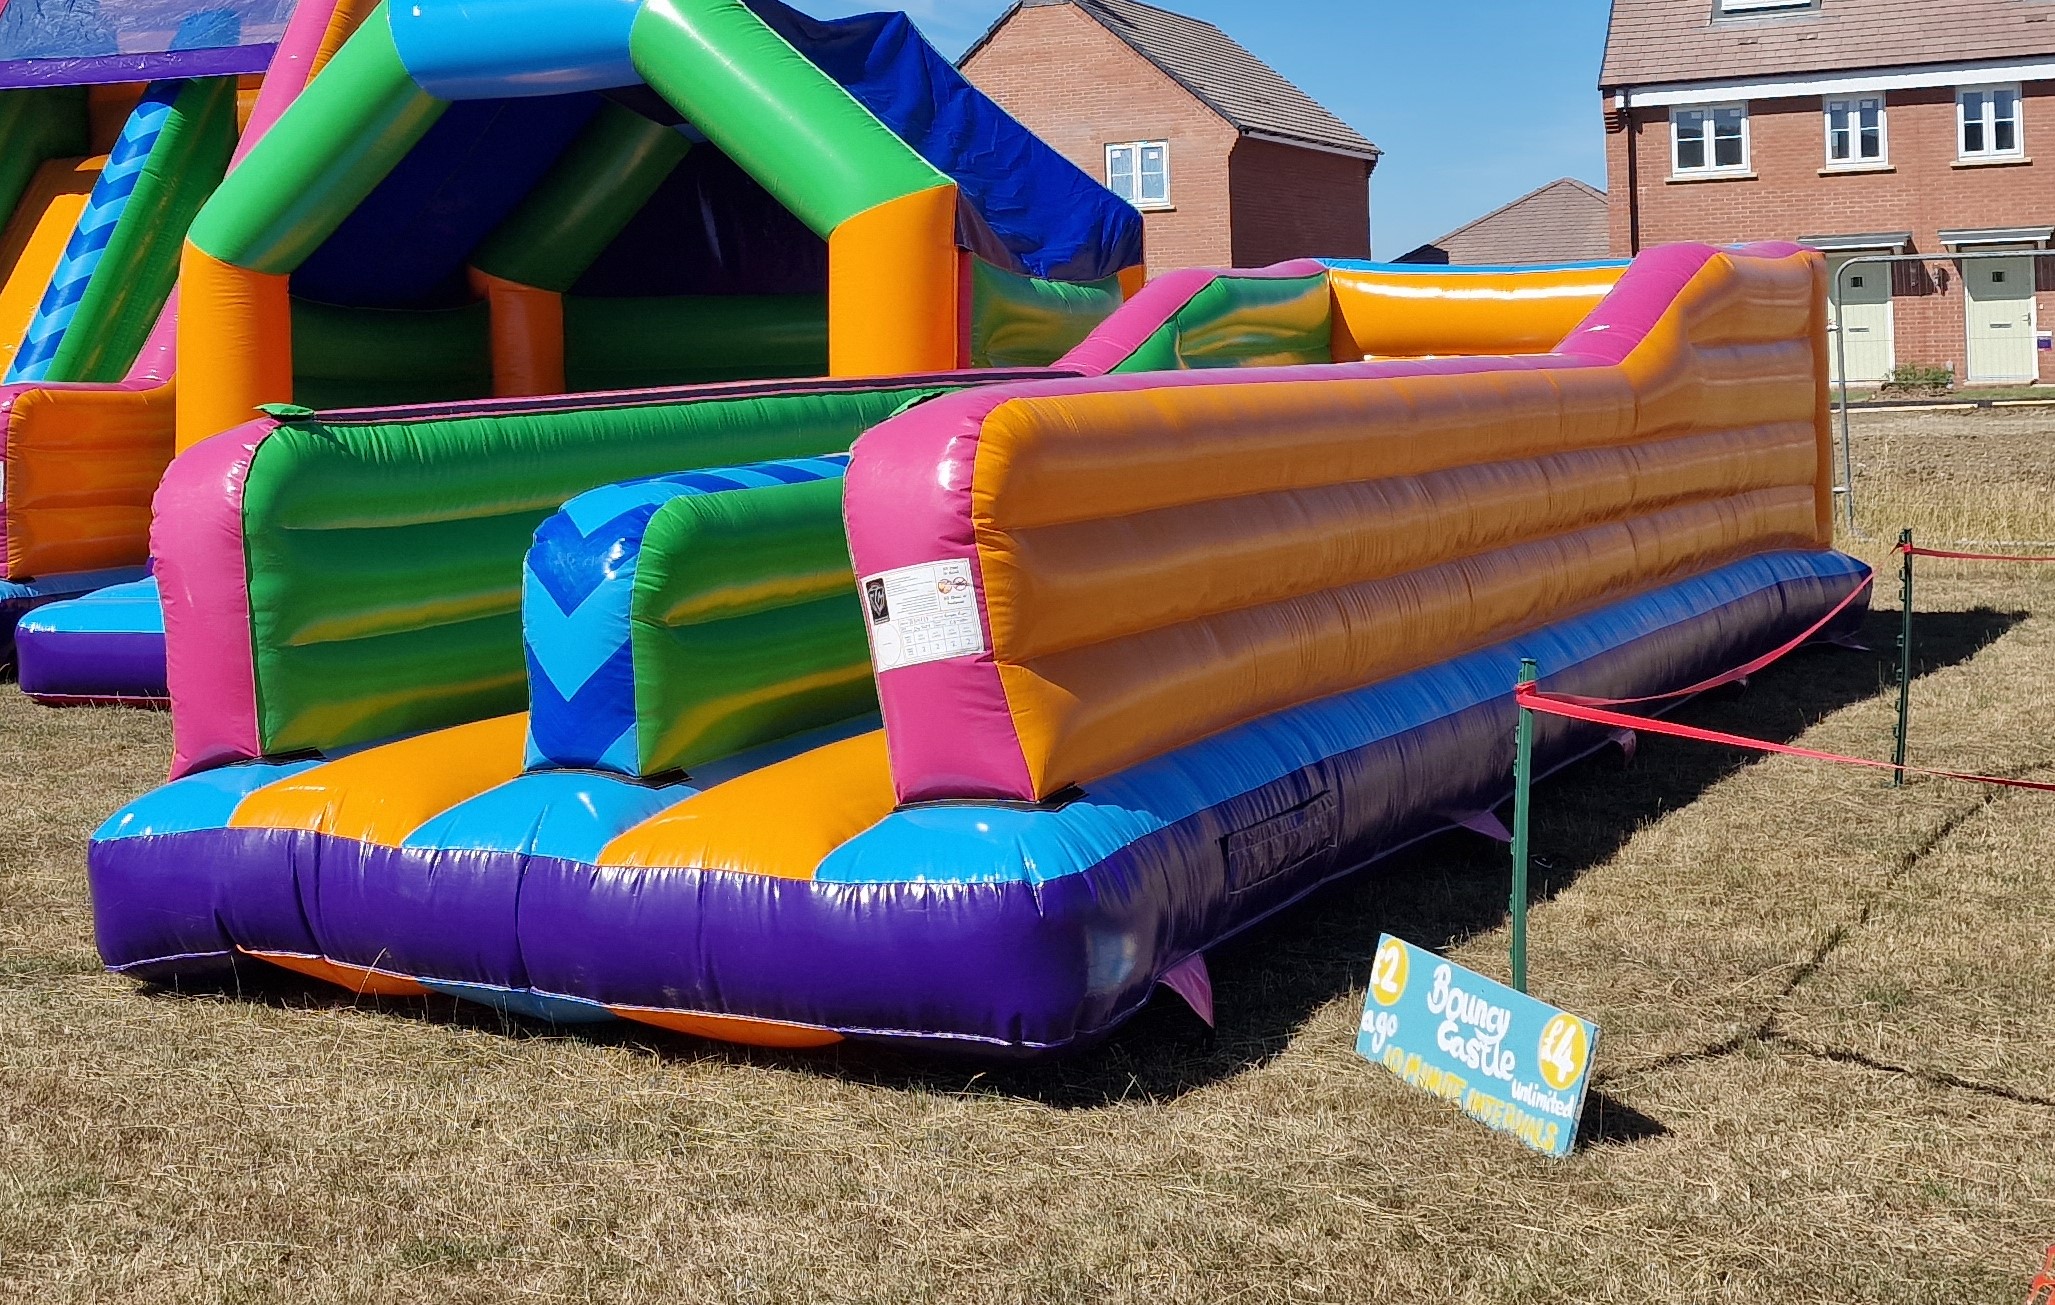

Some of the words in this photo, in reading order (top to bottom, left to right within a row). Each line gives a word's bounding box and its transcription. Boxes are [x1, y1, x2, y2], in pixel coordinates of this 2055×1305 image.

[1427, 964, 1511, 1043] Bouncy
[1437, 1020, 1516, 1081] Castle
[1541, 1019, 1576, 1083] £4
